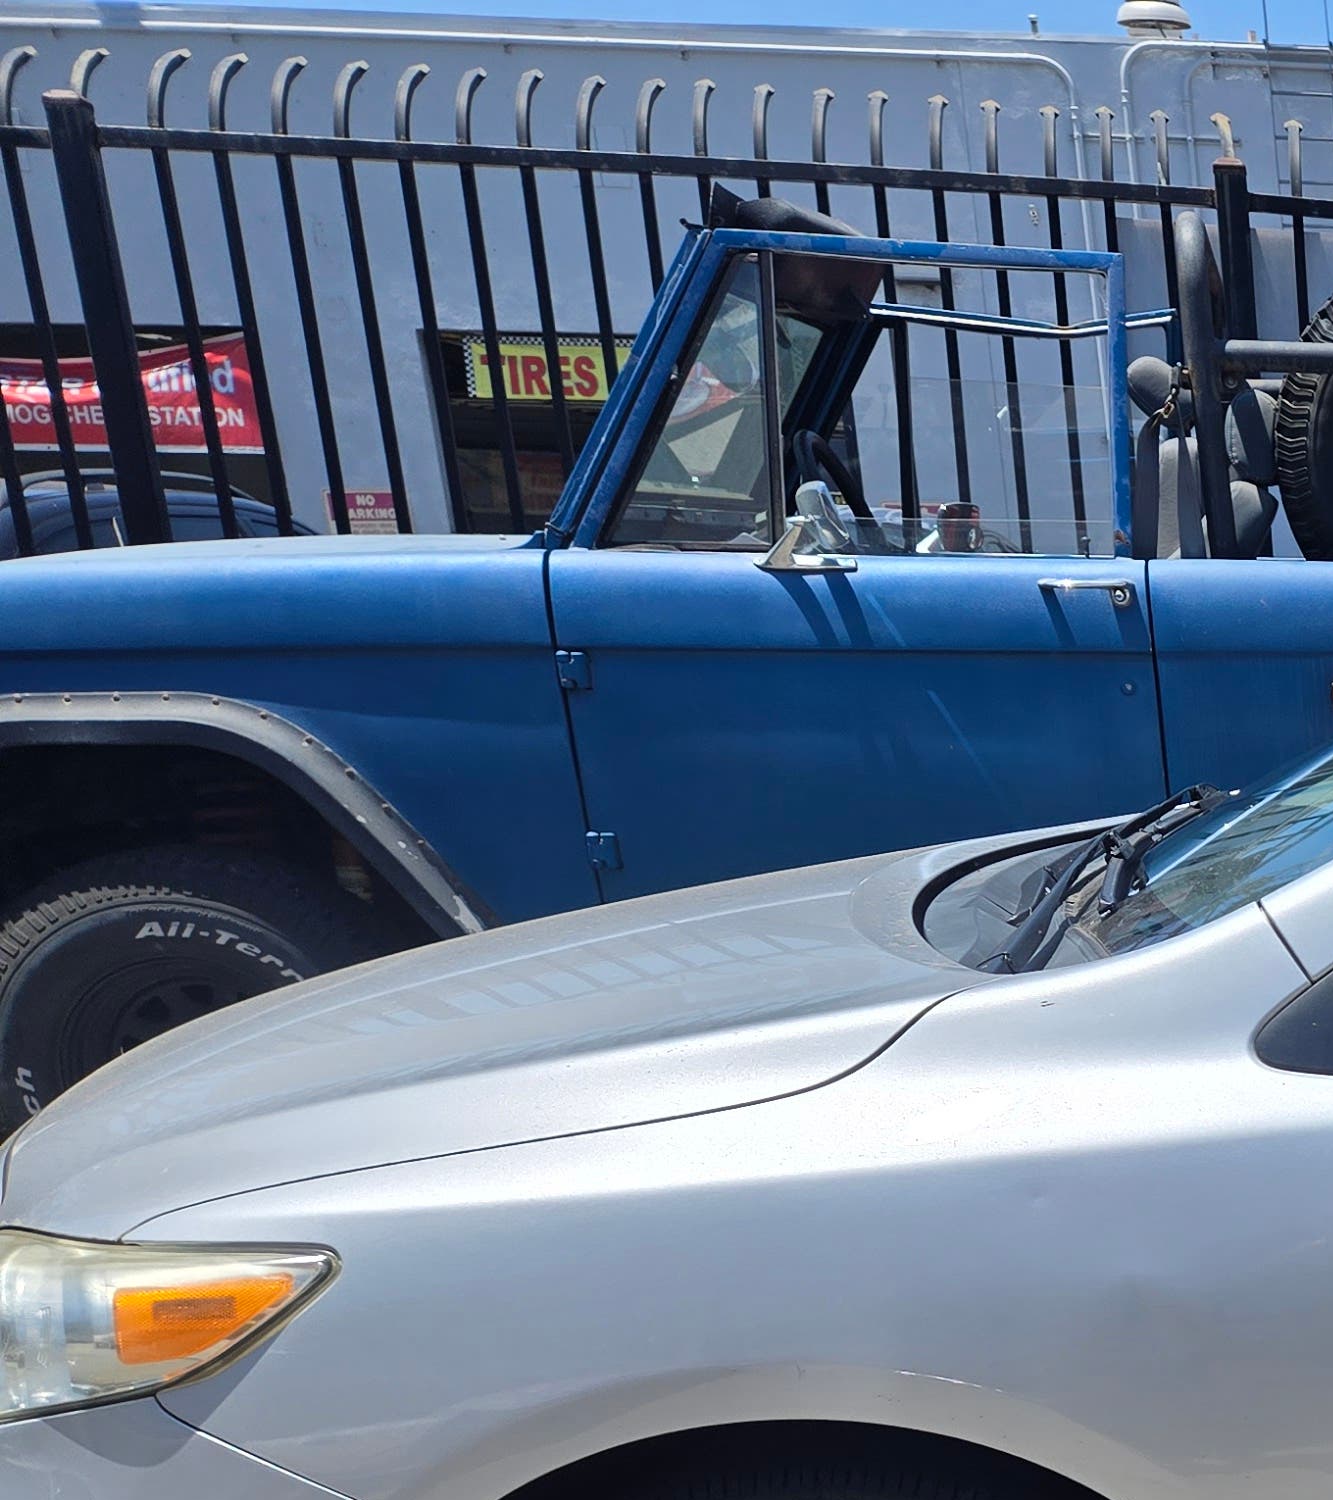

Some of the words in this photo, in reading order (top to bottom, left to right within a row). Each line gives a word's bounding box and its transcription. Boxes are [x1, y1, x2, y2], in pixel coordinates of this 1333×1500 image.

[149, 404, 245, 427] STATON
[355, 494, 376, 506] NO
[348, 508, 396, 519] ARKING
